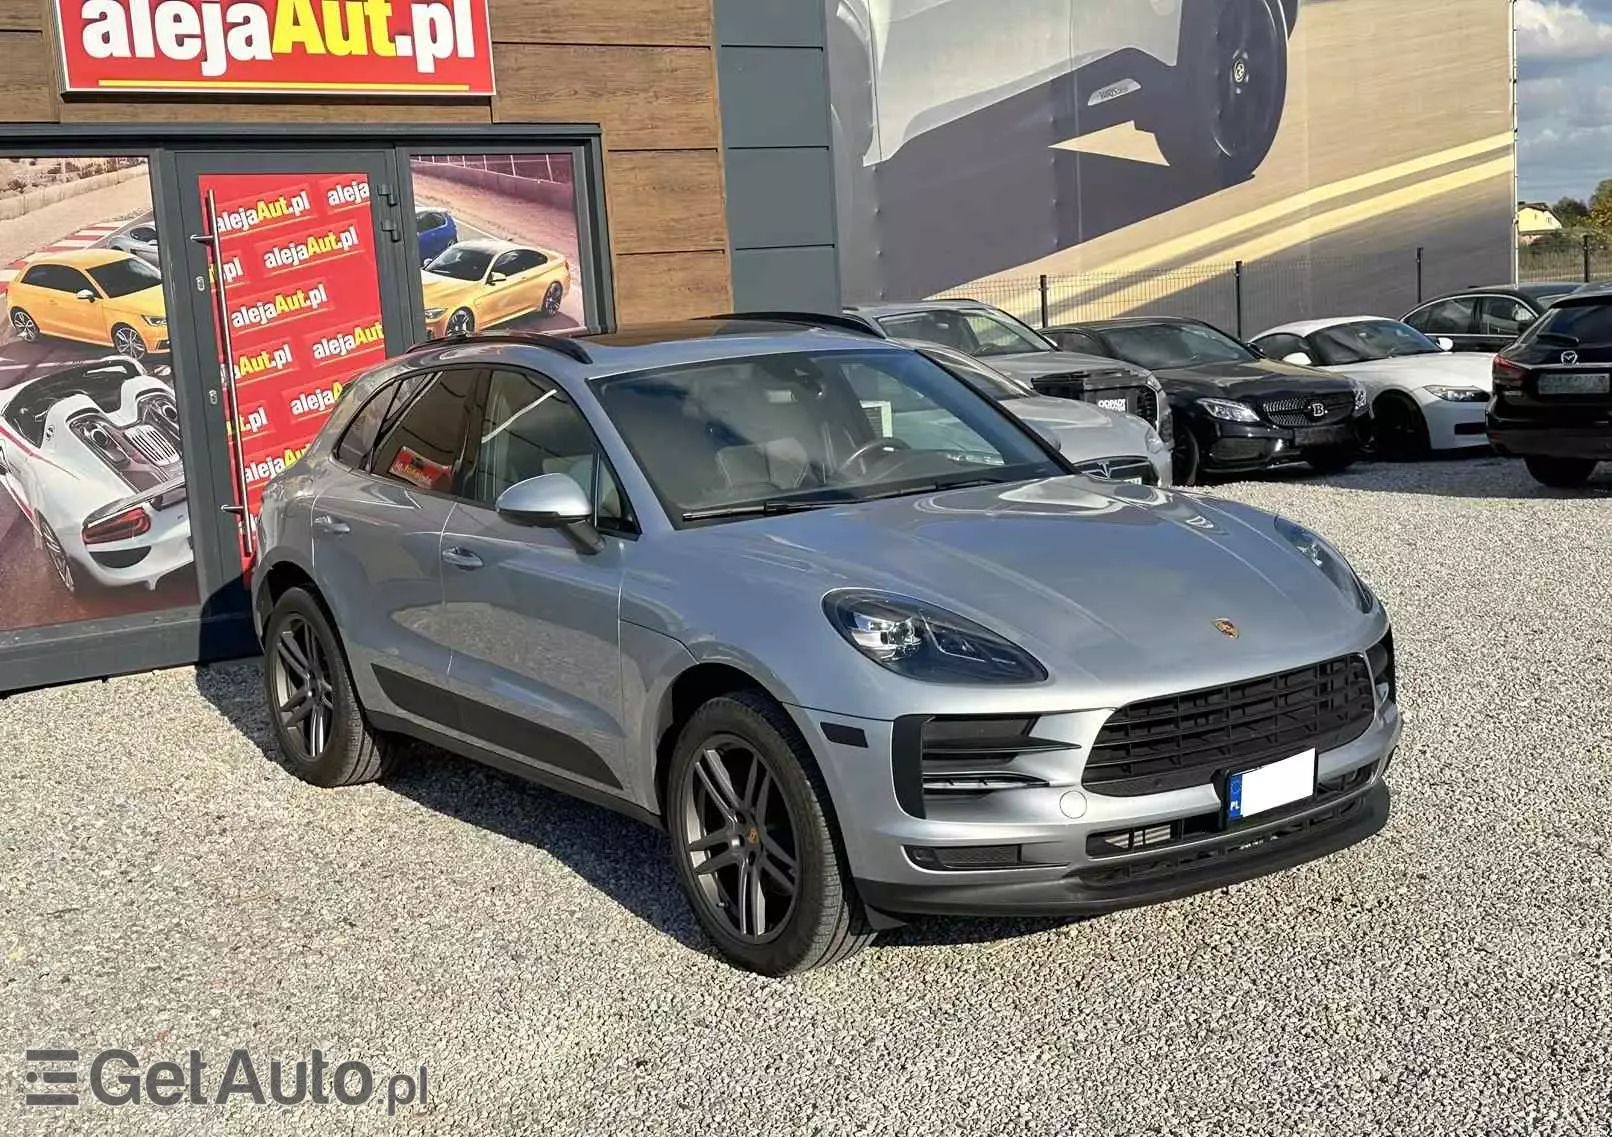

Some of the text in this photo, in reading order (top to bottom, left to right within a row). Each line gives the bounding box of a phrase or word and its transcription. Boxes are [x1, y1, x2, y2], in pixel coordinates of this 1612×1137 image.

[81, 0, 475, 76] alejaAut.pl
[217, 191, 310, 232] alejaAut.pl
[263, 226, 358, 270] alejaAut.pl
[231, 283, 328, 328] alejaAut.pl
[1230, 800, 1240, 811] PL
